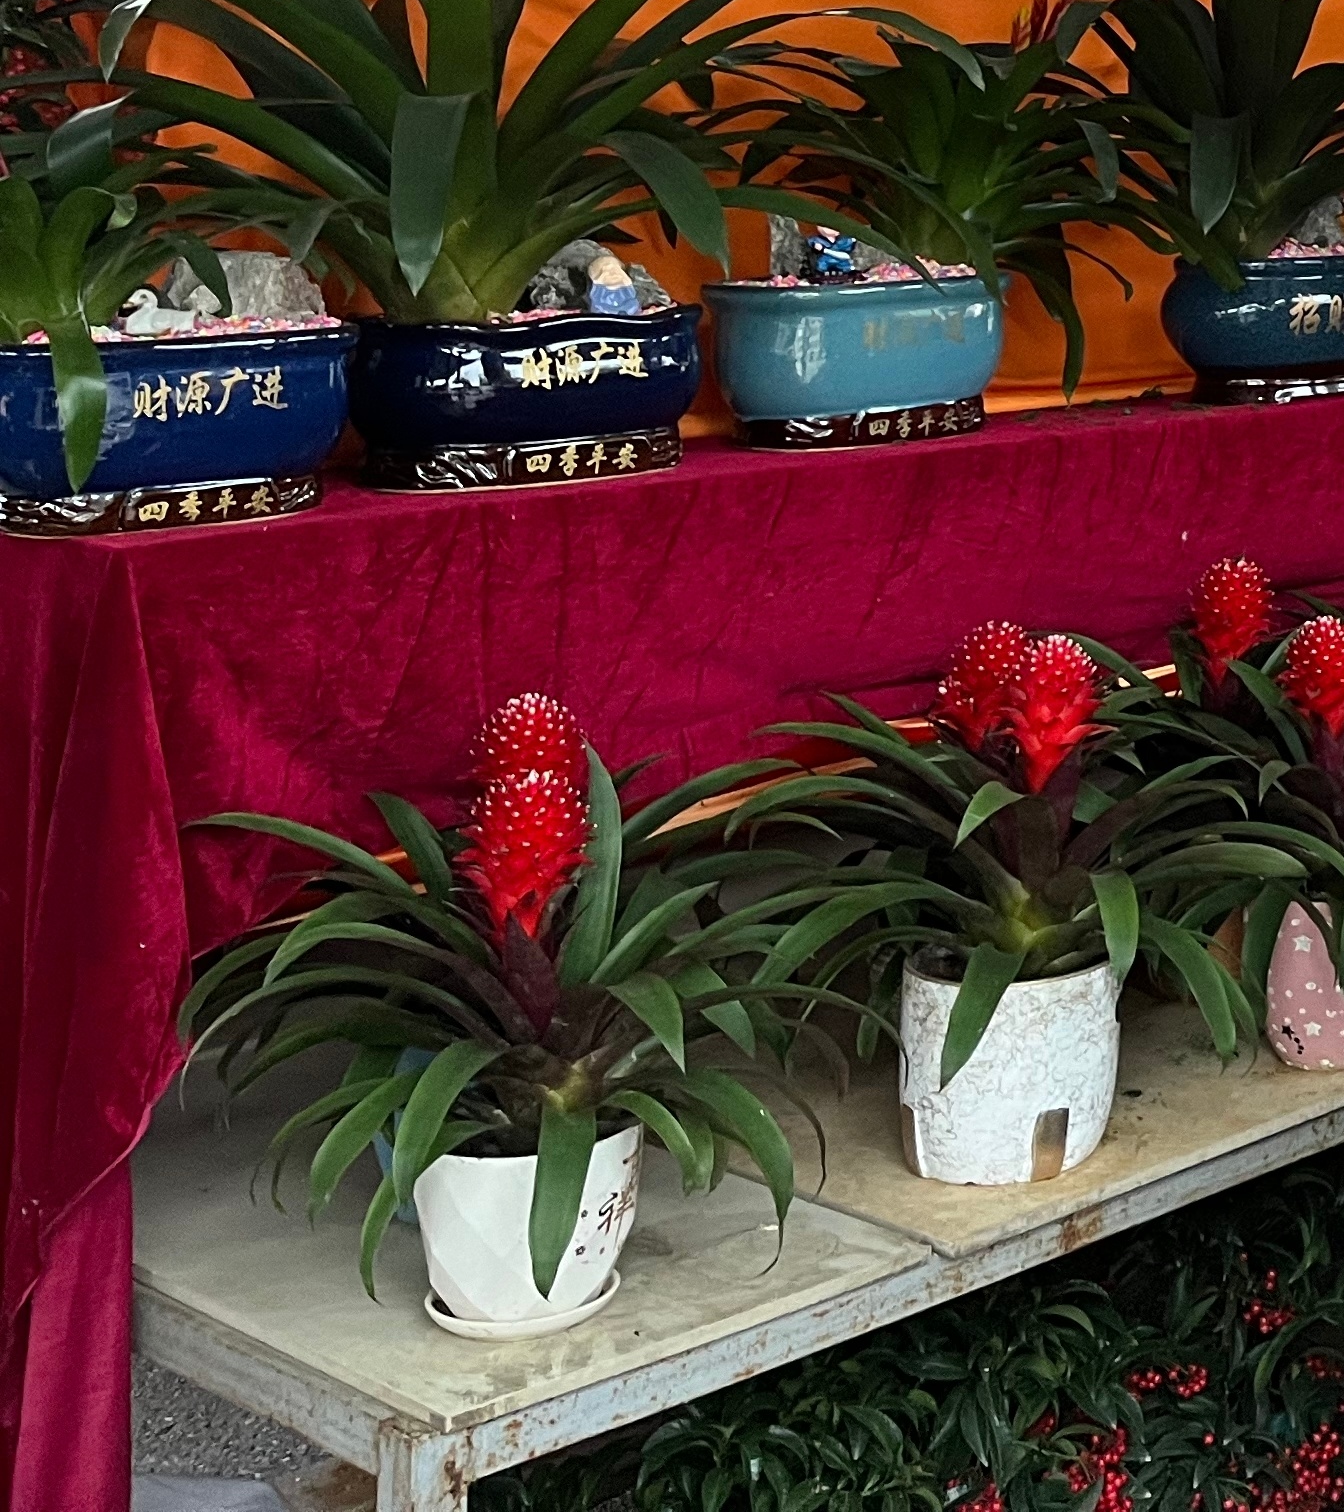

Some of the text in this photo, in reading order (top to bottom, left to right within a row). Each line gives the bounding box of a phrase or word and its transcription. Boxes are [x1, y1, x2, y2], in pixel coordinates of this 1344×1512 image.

[521, 340, 649, 390] 财源广进
[132, 365, 289, 422] 财源广进
[868, 408, 959, 438] 四季平安
[526, 442, 638, 476] 四季平安
[138, 485, 275, 522] 四季平安
